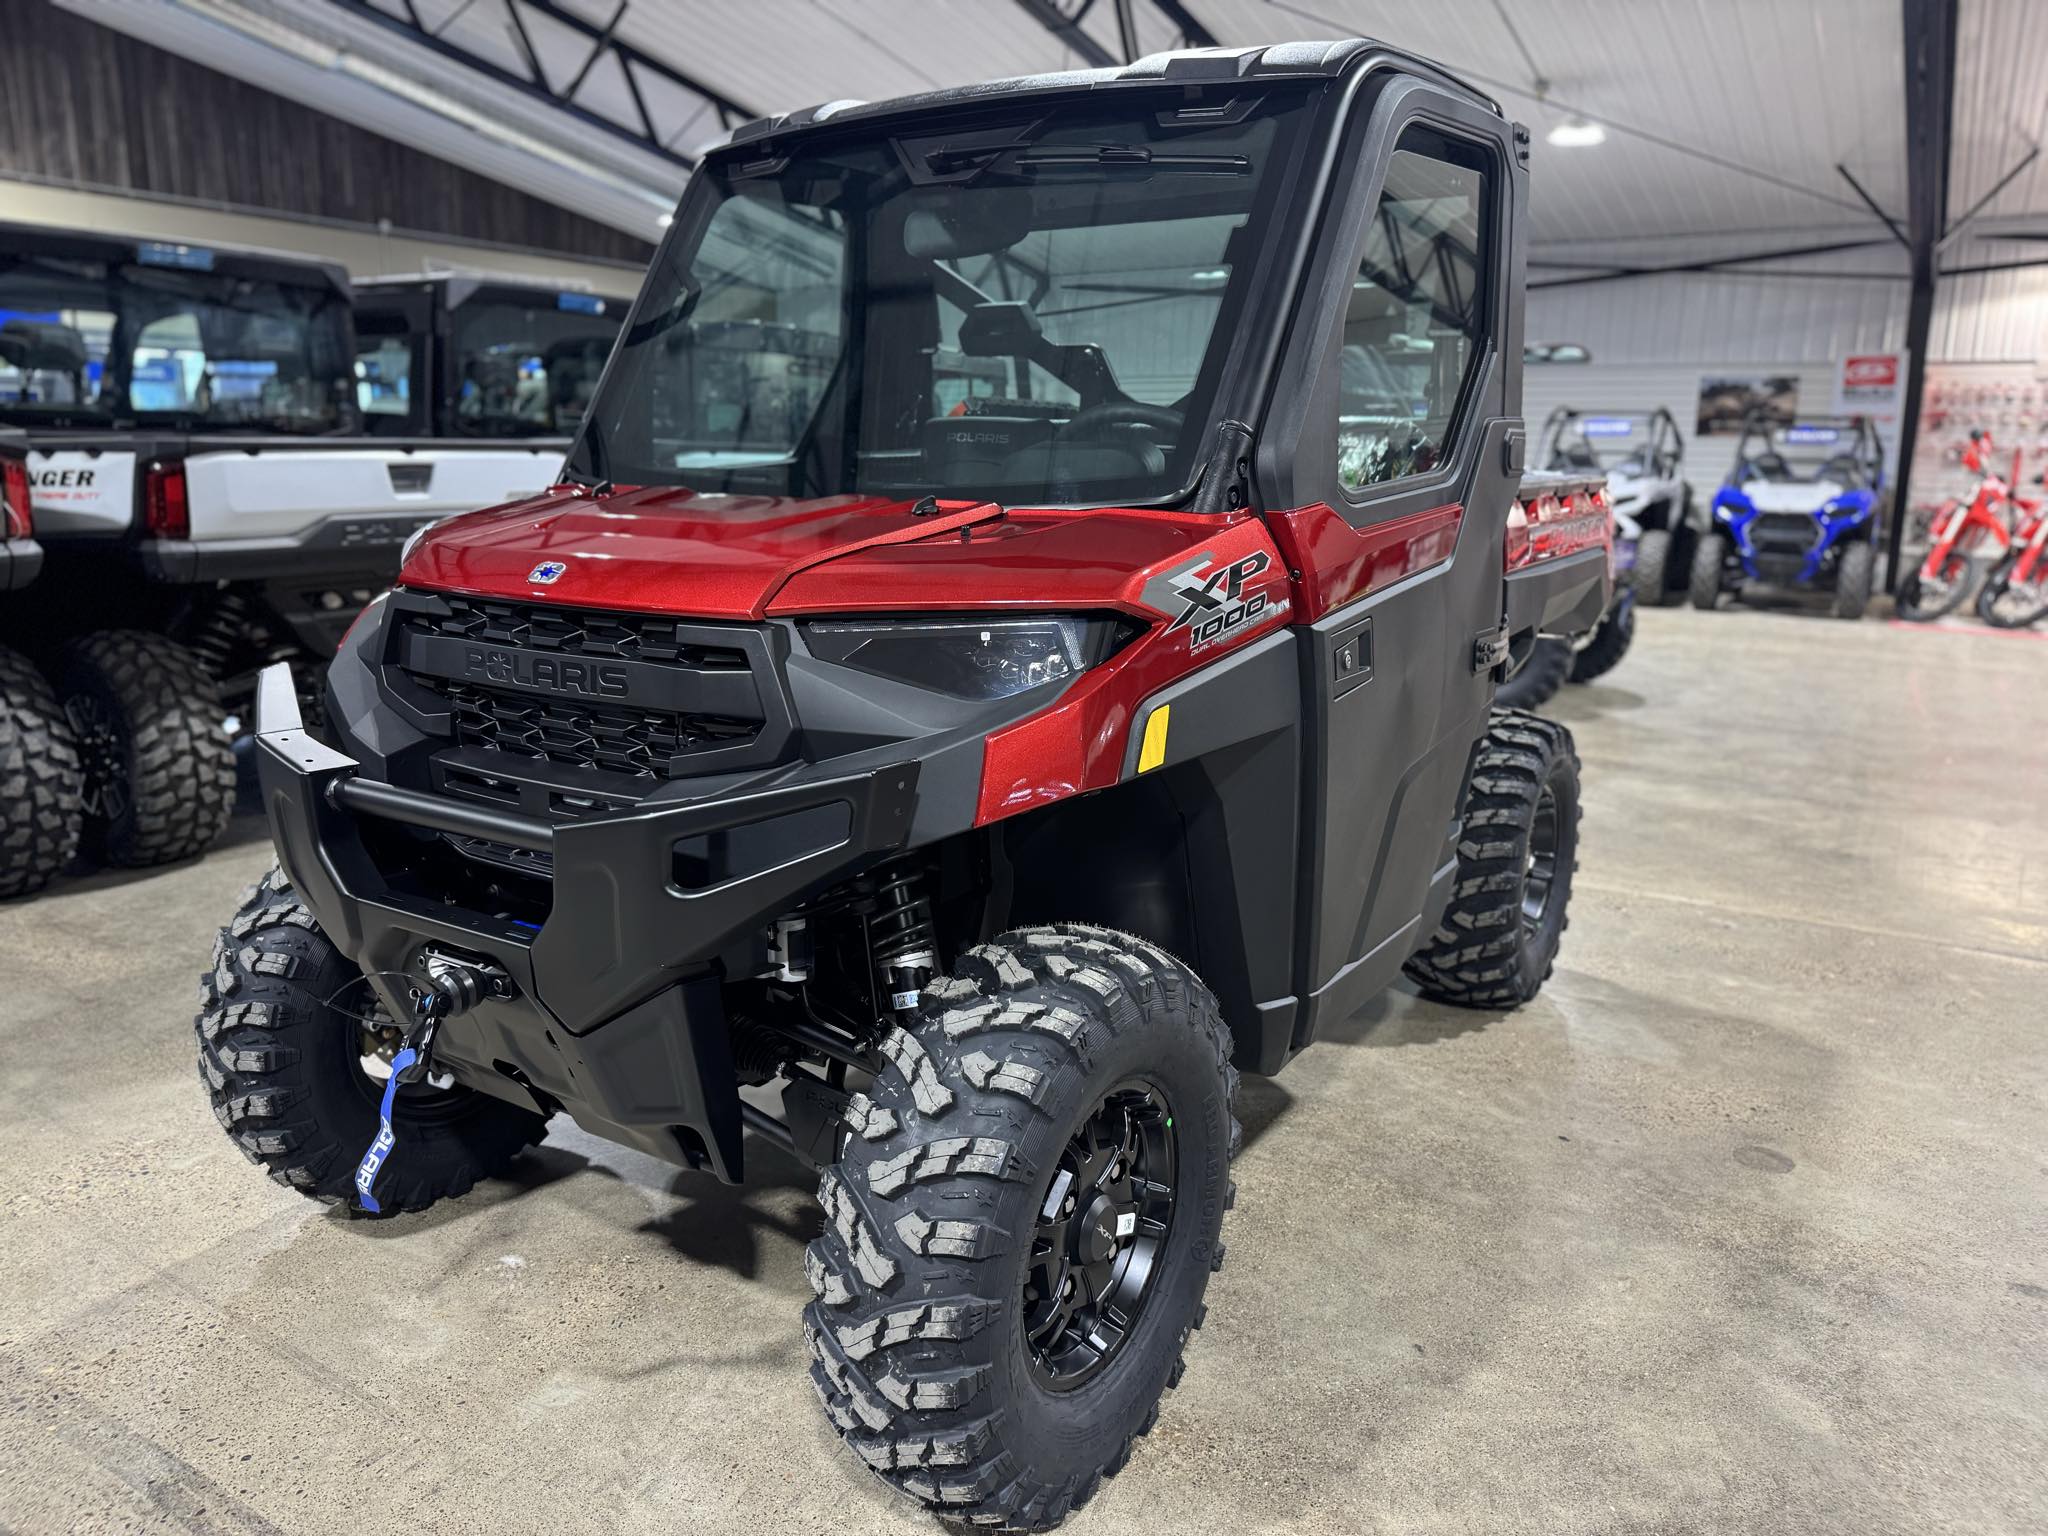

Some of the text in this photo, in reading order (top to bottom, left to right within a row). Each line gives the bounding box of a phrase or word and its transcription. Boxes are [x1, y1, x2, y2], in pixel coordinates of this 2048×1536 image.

[947, 432, 1009, 444] POLARIS
[28, 468, 95, 488] NGER
[1160, 549, 1271, 638] XP
[1189, 591, 1267, 650] 1000
[1190, 642, 1211, 656] DUAL
[1211, 621, 1249, 645] OVERHEAD
[465, 648, 630, 699] POLARIS
